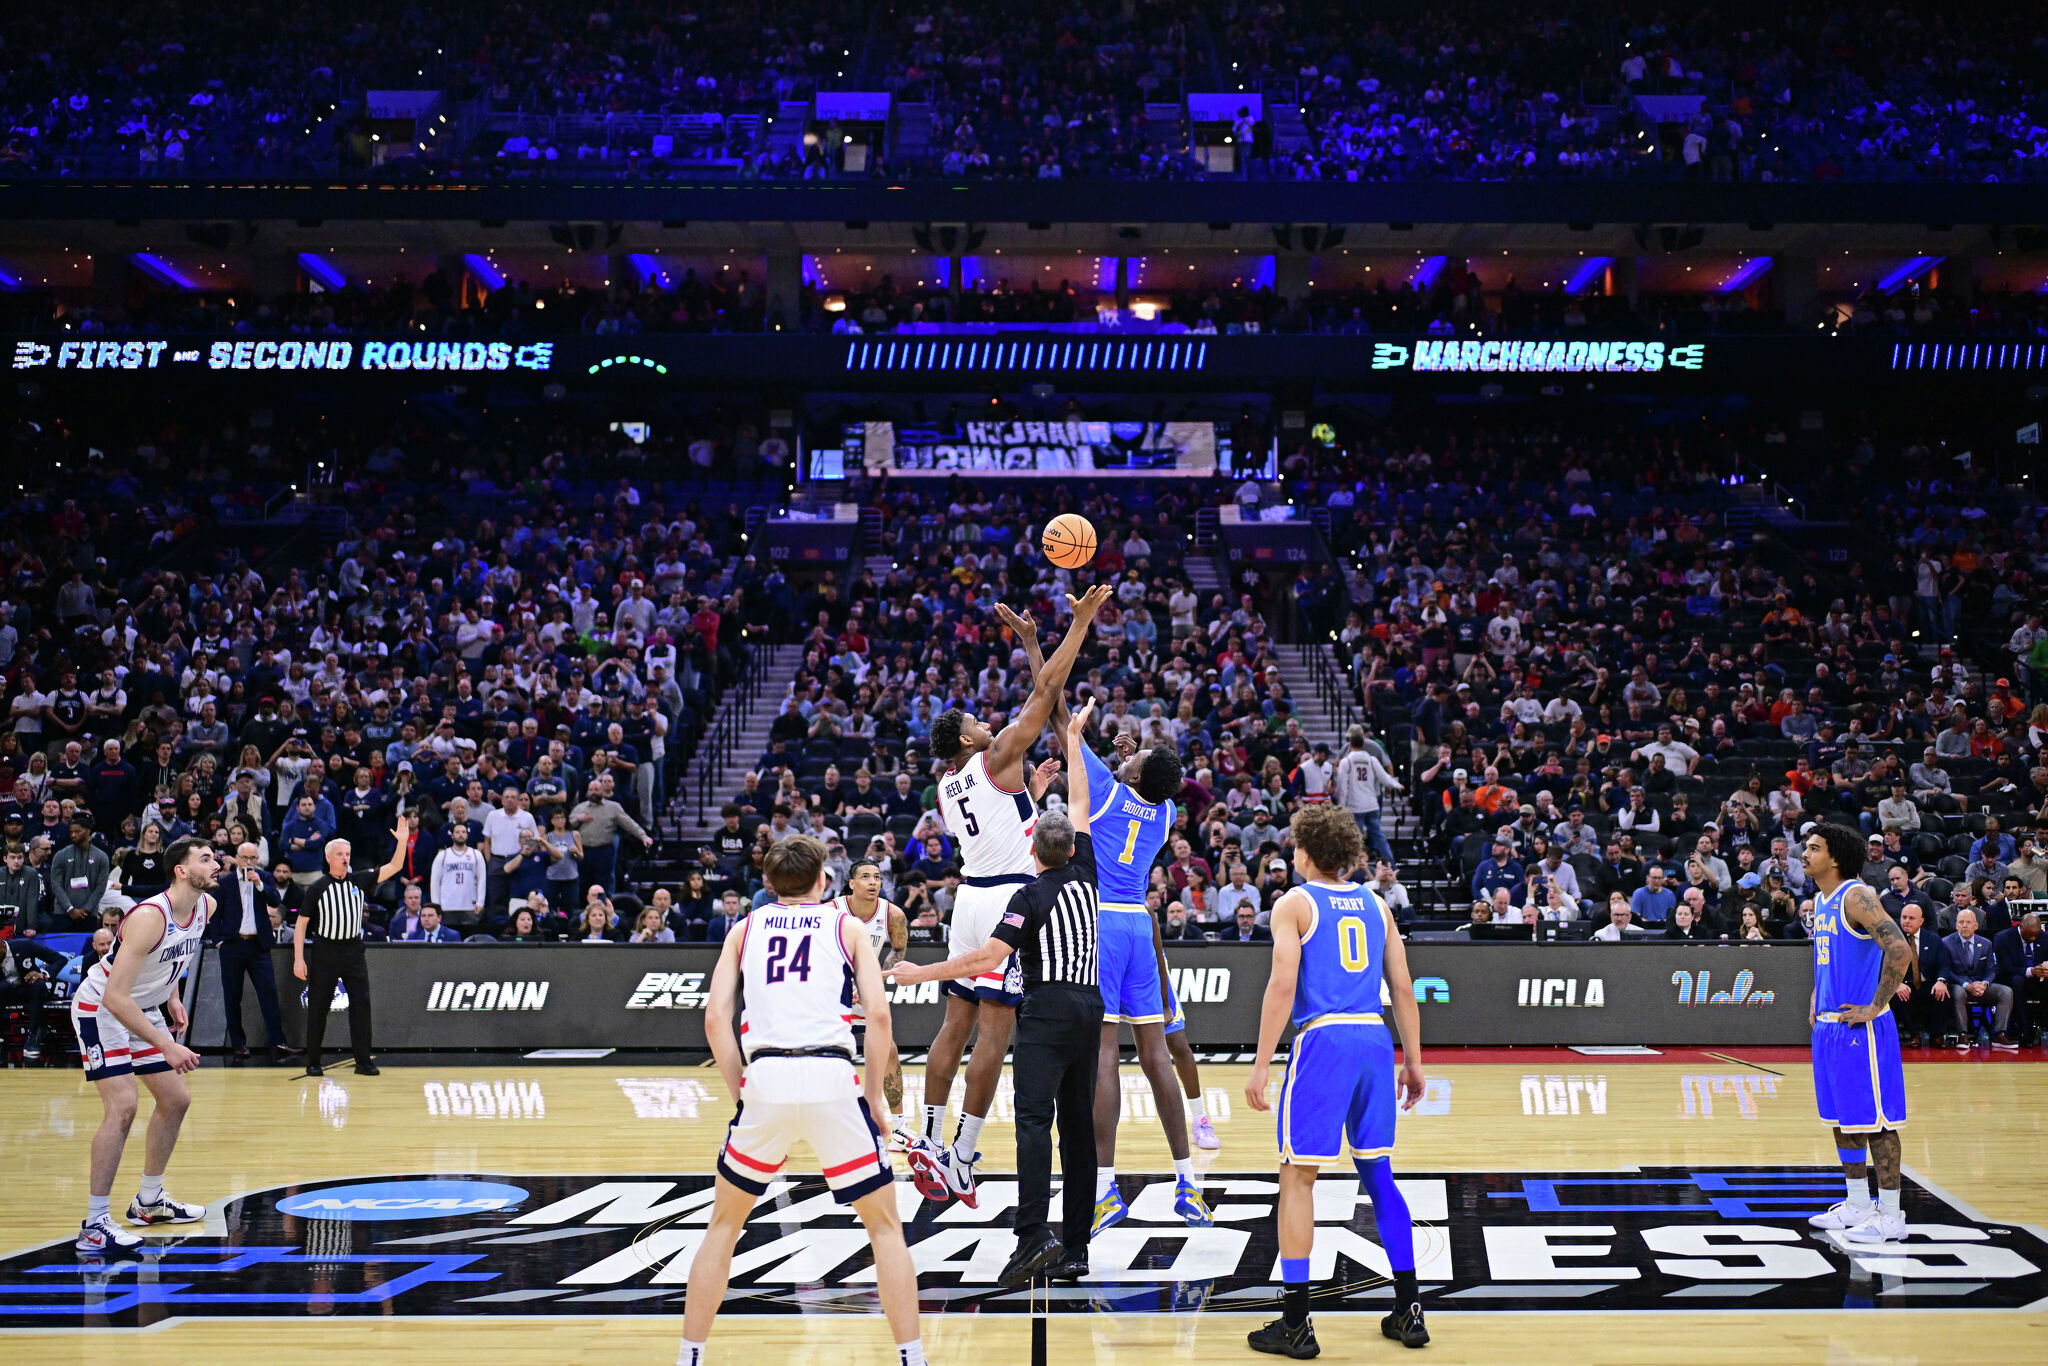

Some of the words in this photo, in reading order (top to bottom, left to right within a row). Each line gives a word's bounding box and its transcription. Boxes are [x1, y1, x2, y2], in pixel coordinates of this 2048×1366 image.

[57, 341, 167, 369] FIRST
[172, 350, 200, 362] AND
[207, 341, 352, 370] SECOND
[360, 341, 512, 370] ROUNDS
[769, 546, 791, 559] 102
[1286, 548, 1307, 561] 124
[1827, 548, 1848, 561] 123
[1500, 625, 1512, 641] 9
[67, 707, 74, 719] 3
[1356, 767, 1368, 781] 32
[945, 780, 963, 800] REED
[964, 773, 978, 790] JR.
[957, 796, 980, 837] 5
[1121, 799, 1157, 821] BOOKER
[721, 838, 744, 849] USA
[1117, 819, 1142, 865] 1
[455, 873, 464, 885] 21
[1328, 896, 1366, 911] PERRY
[764, 916, 822, 930] MULLINS
[1815, 913, 1838, 936] CLA
[909, 929, 931, 938] POSS.
[1337, 916, 1369, 973] 0
[1816, 936, 1830, 965] 55
[766, 934, 812, 985] 24
[165, 961, 185, 986] 11
[635, 972, 706, 992] BIG
[425, 981, 550, 1011] UCONN
[1517, 979, 1605, 1008] UCLA
[290, 1198, 510, 1210] NCAA
